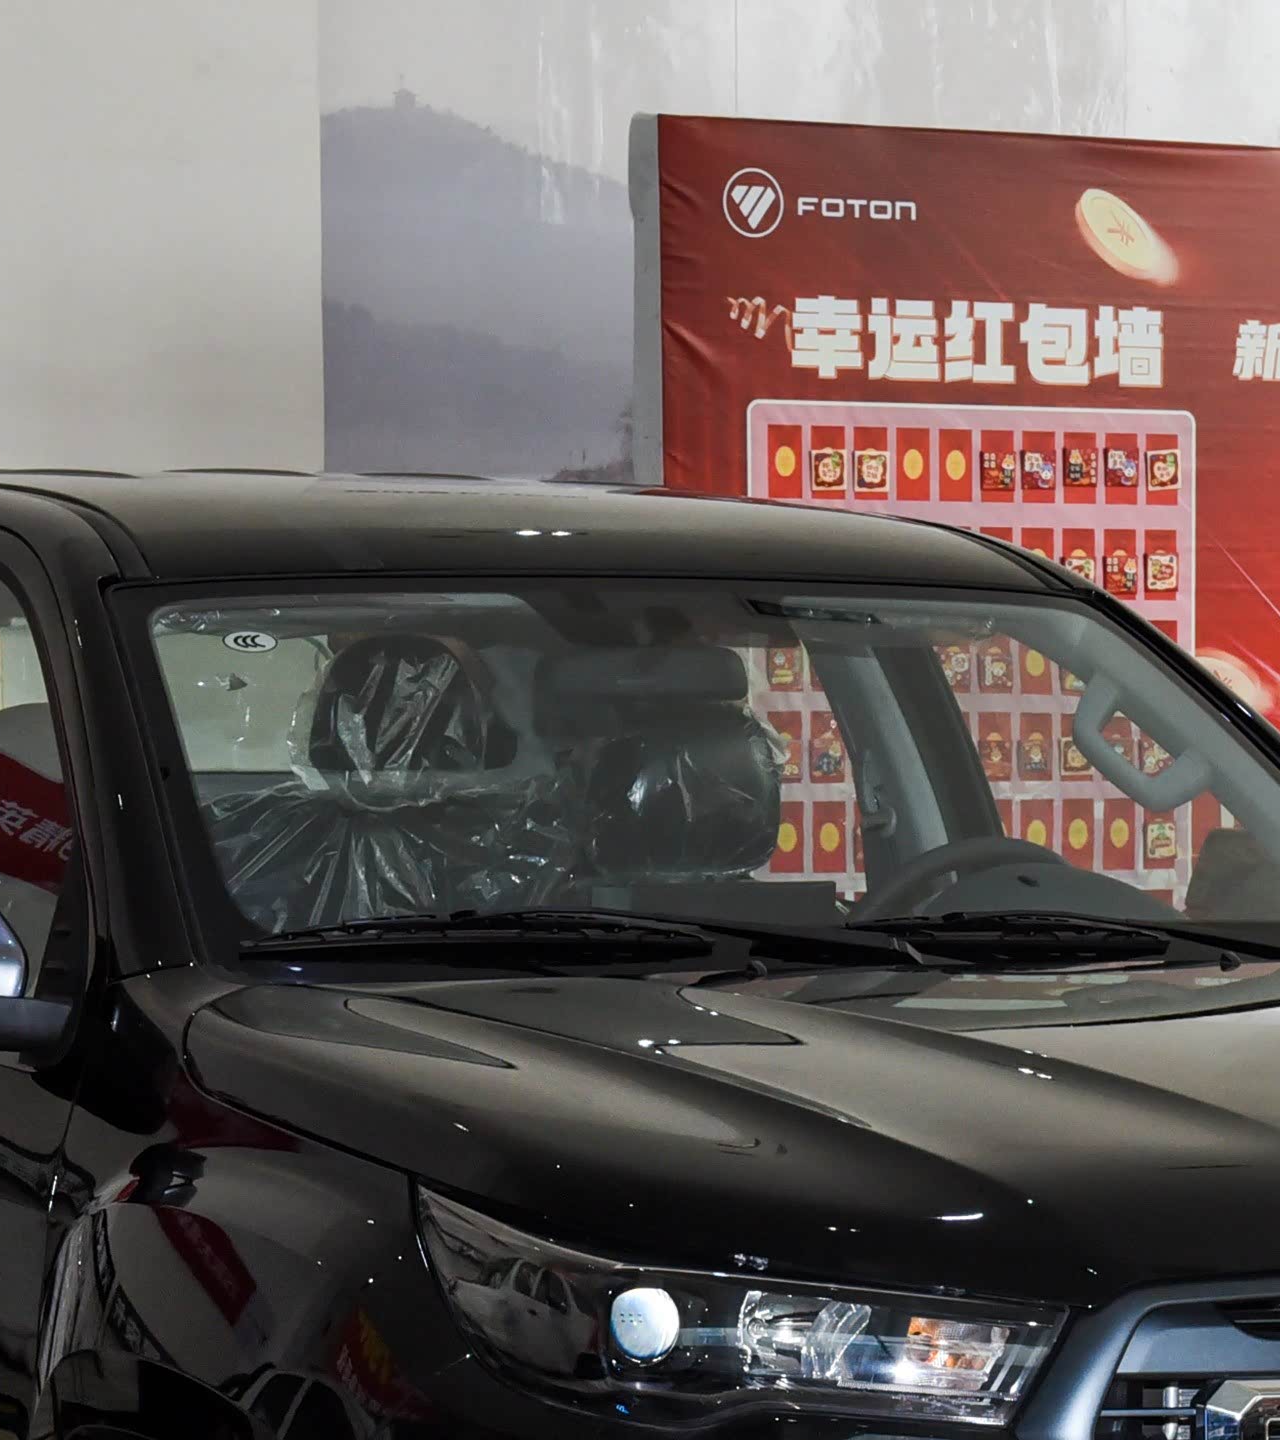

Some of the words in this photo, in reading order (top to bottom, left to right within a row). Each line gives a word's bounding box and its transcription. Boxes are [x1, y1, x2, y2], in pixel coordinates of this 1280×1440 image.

[797, 197, 917, 221] FOTON
[791, 295, 1163, 388] 幸运红包墙
